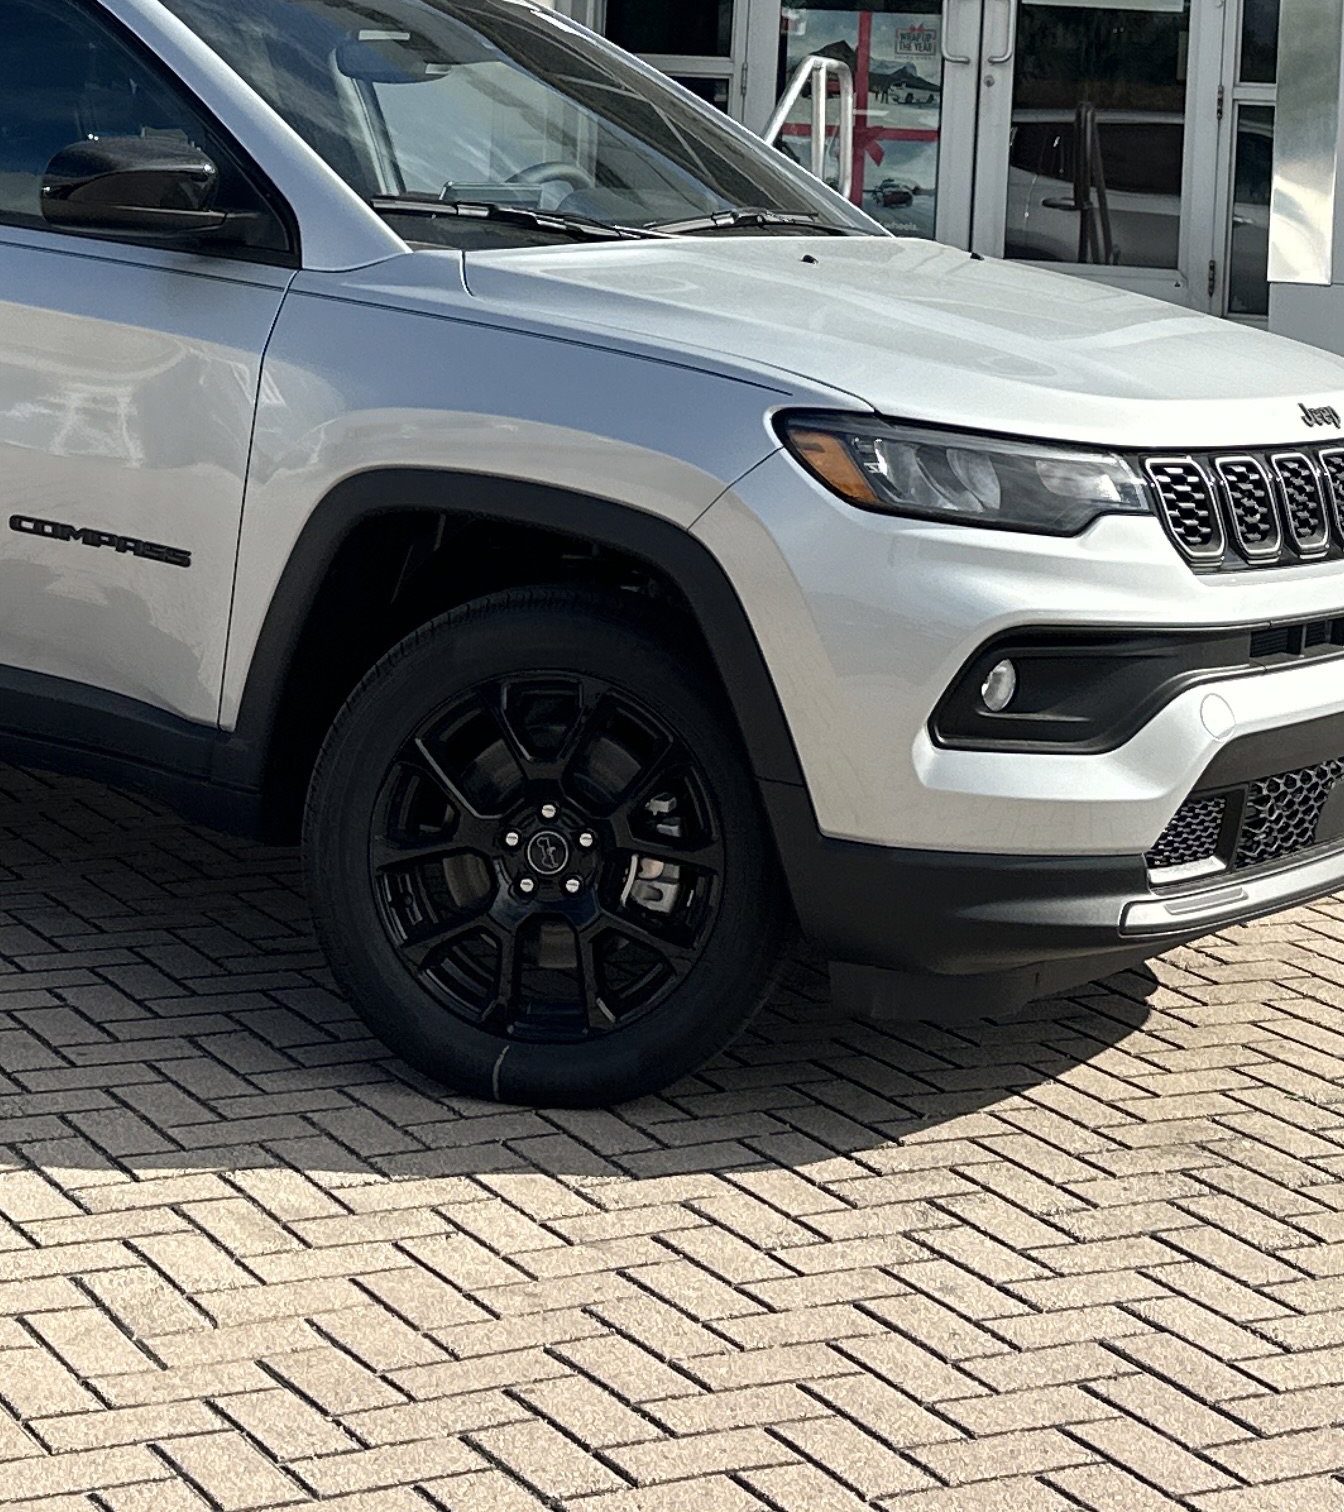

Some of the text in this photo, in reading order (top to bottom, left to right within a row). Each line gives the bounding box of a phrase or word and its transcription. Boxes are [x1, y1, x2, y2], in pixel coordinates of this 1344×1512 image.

[899, 40, 933, 53] THE YEAR
[1297, 402, 1341, 429] Jeep
[9, 514, 191, 568] COMPASS
